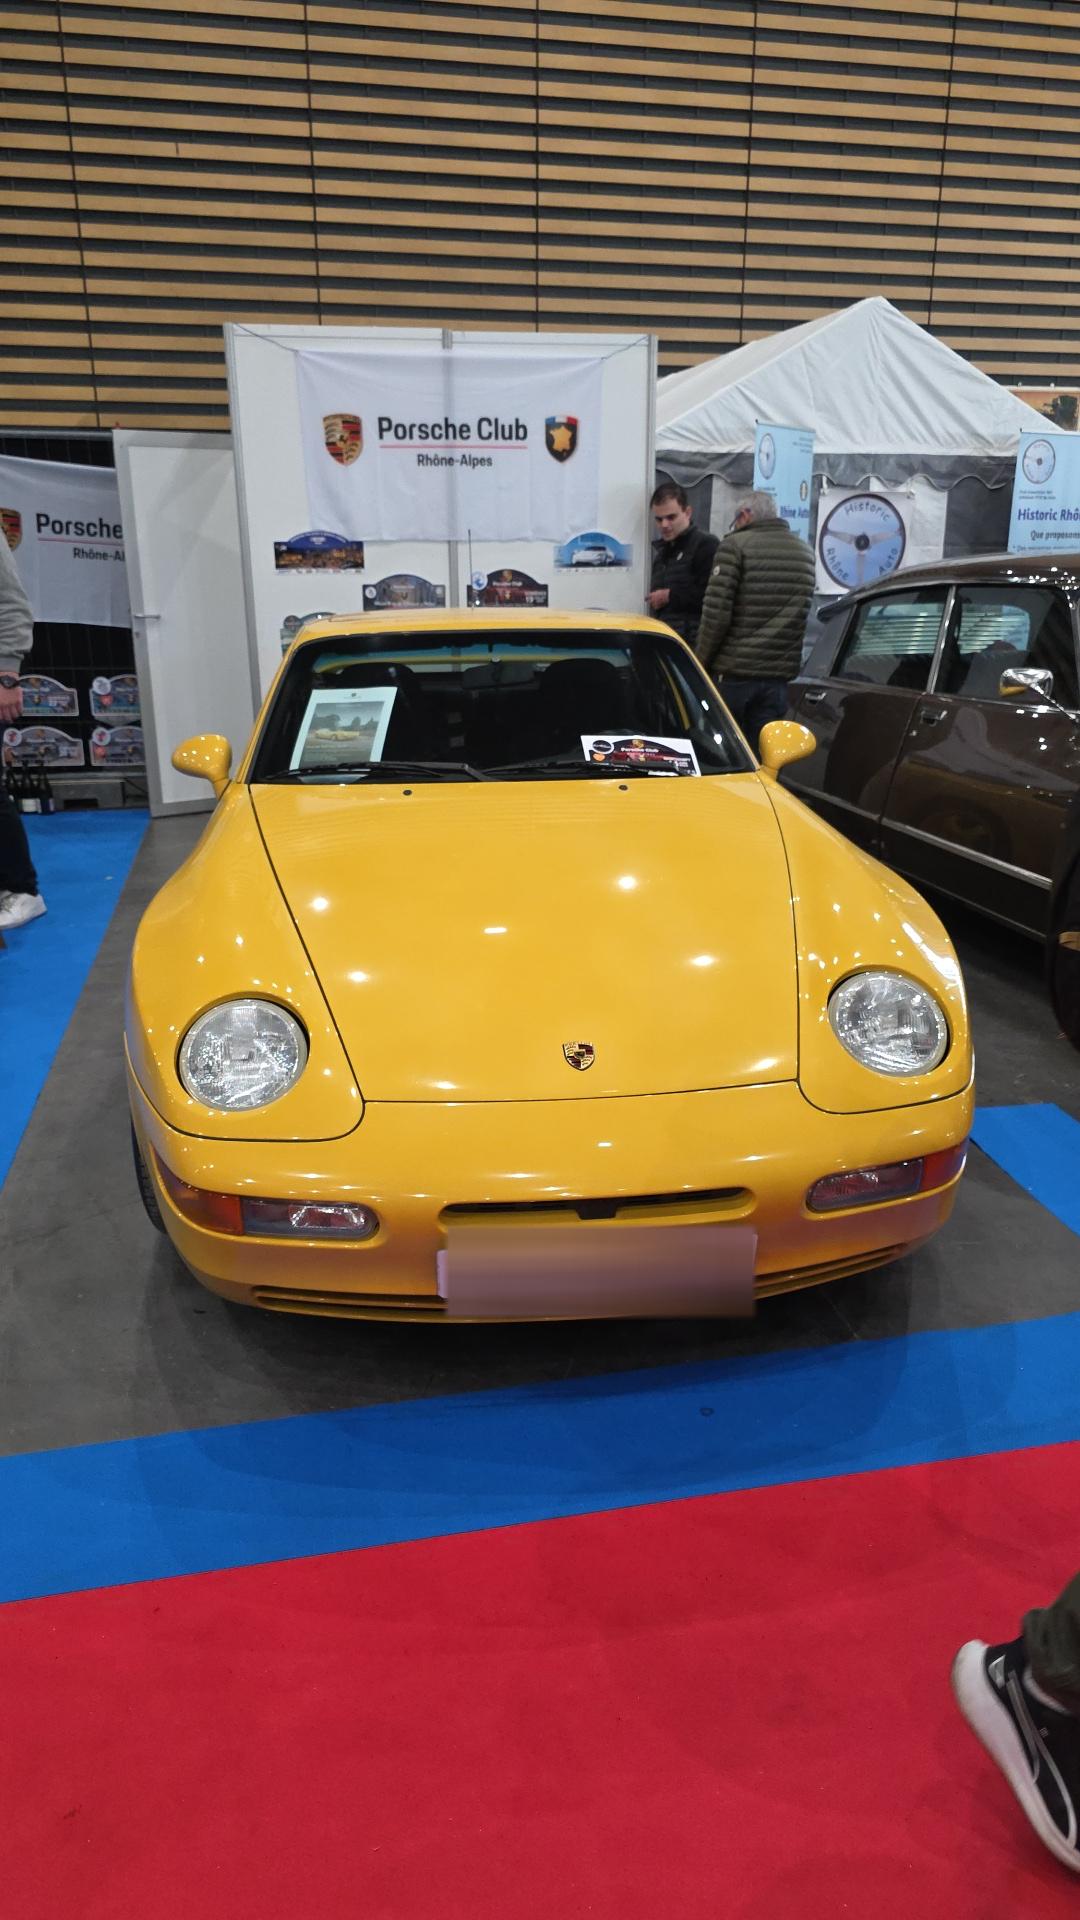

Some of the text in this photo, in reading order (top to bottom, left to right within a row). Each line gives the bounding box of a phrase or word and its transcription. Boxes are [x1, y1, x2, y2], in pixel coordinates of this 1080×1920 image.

[378, 416, 528, 441] Porsche Club
[417, 453, 493, 469] Rhône-Alpes
[844, 501, 890, 522] Historic
[1018, 507, 1080, 521] Historic Rhô
[36, 512, 123, 540] Porsche
[879, 546, 898, 573] Auto
